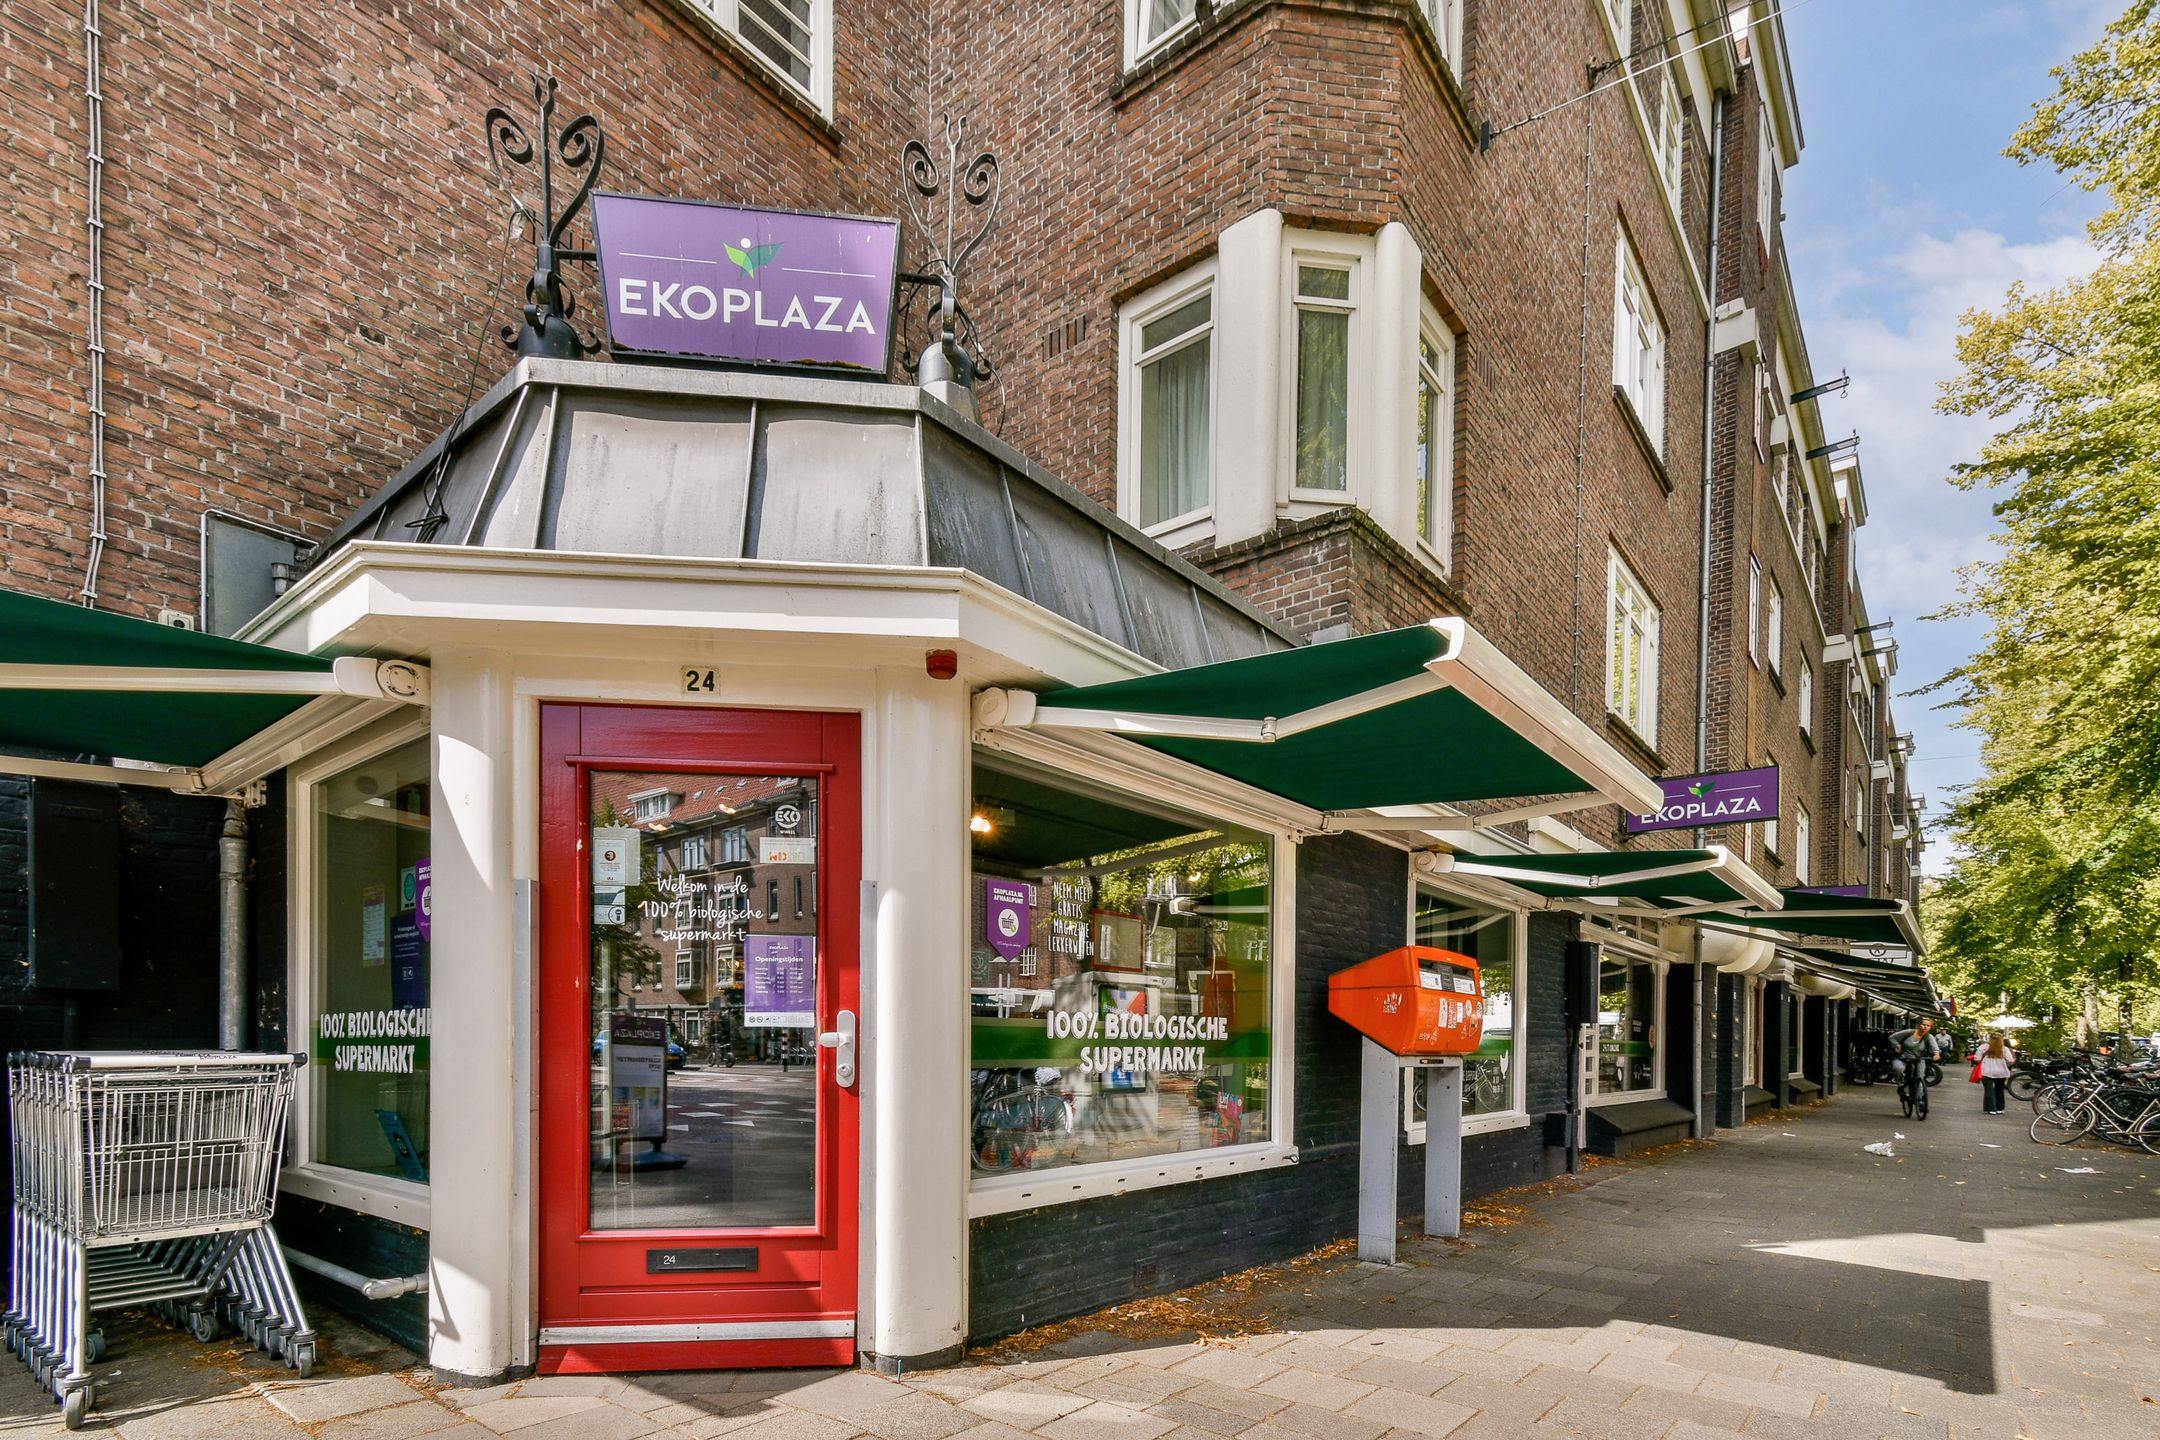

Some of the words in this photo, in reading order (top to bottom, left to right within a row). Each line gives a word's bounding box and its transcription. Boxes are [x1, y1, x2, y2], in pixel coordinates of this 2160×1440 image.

[619, 277, 877, 335] EKOPLAZA
[686, 670, 715, 692] 24
[775, 810, 801, 823] EKO
[1641, 796, 1762, 825] EKOPLAZA
[657, 873, 708, 895] Welkom
[714, 881, 726, 893] in
[730, 875, 749, 895] de
[1053, 881, 1072, 899] NEEM
[639, 899, 683, 919] 100%
[690, 899, 764, 929] biologische
[1058, 900, 1083, 919] GRATIS
[660, 920, 747, 950] supermarkt
[320, 1013, 345, 1038] 100%
[1046, 1010, 1099, 1040] 100%
[1104, 1013, 1228, 1041] BIOLOGISCHE
[335, 1044, 415, 1074] SUPERMARKT
[1079, 1046, 1205, 1074] SUPERMARKT
[663, 1255, 676, 1265] 24
